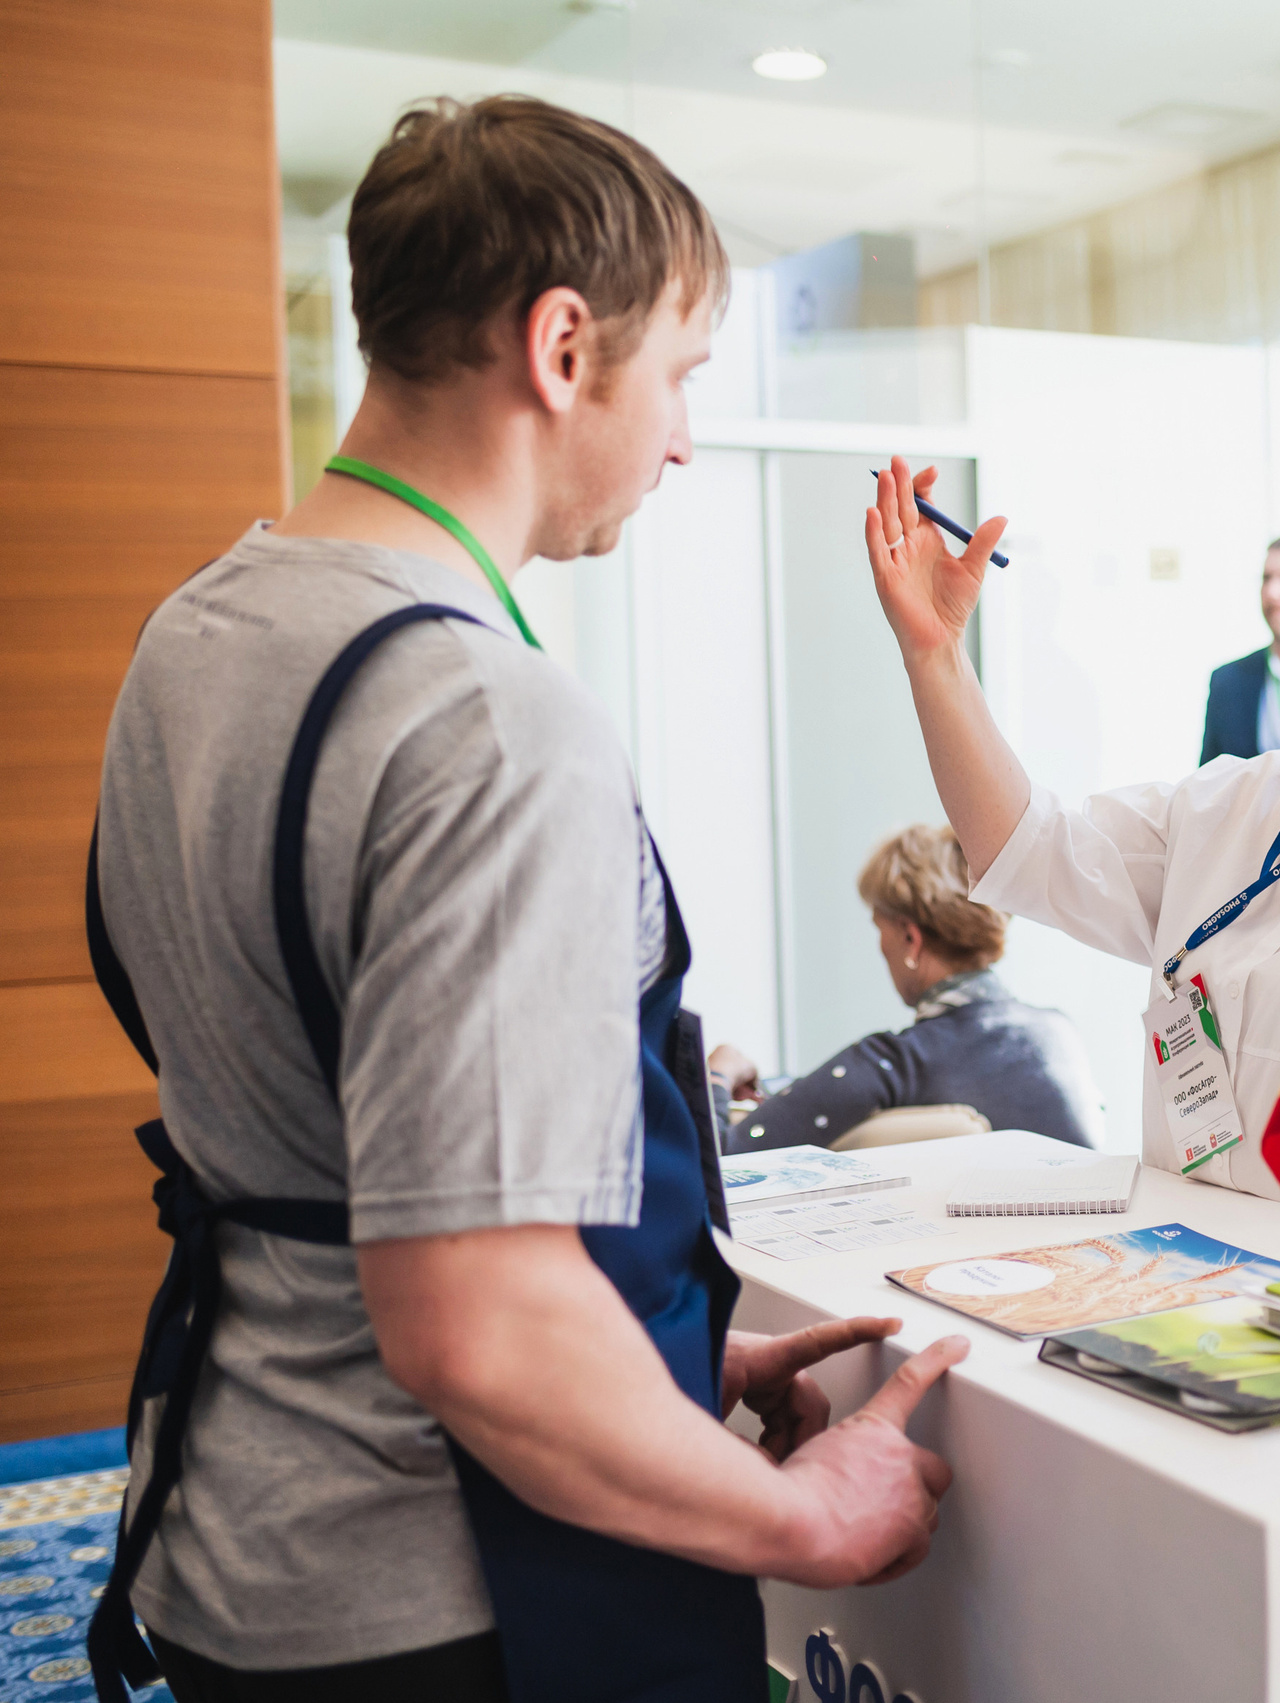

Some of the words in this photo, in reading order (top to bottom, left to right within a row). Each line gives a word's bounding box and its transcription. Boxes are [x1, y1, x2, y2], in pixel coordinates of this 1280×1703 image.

[1202, 898, 1241, 931] PHOSAGRO
[1165, 1022, 1179, 1037] МАК
[1178, 1013, 1191, 1029] 2023
[1174, 1091, 1187, 1106] ООО
